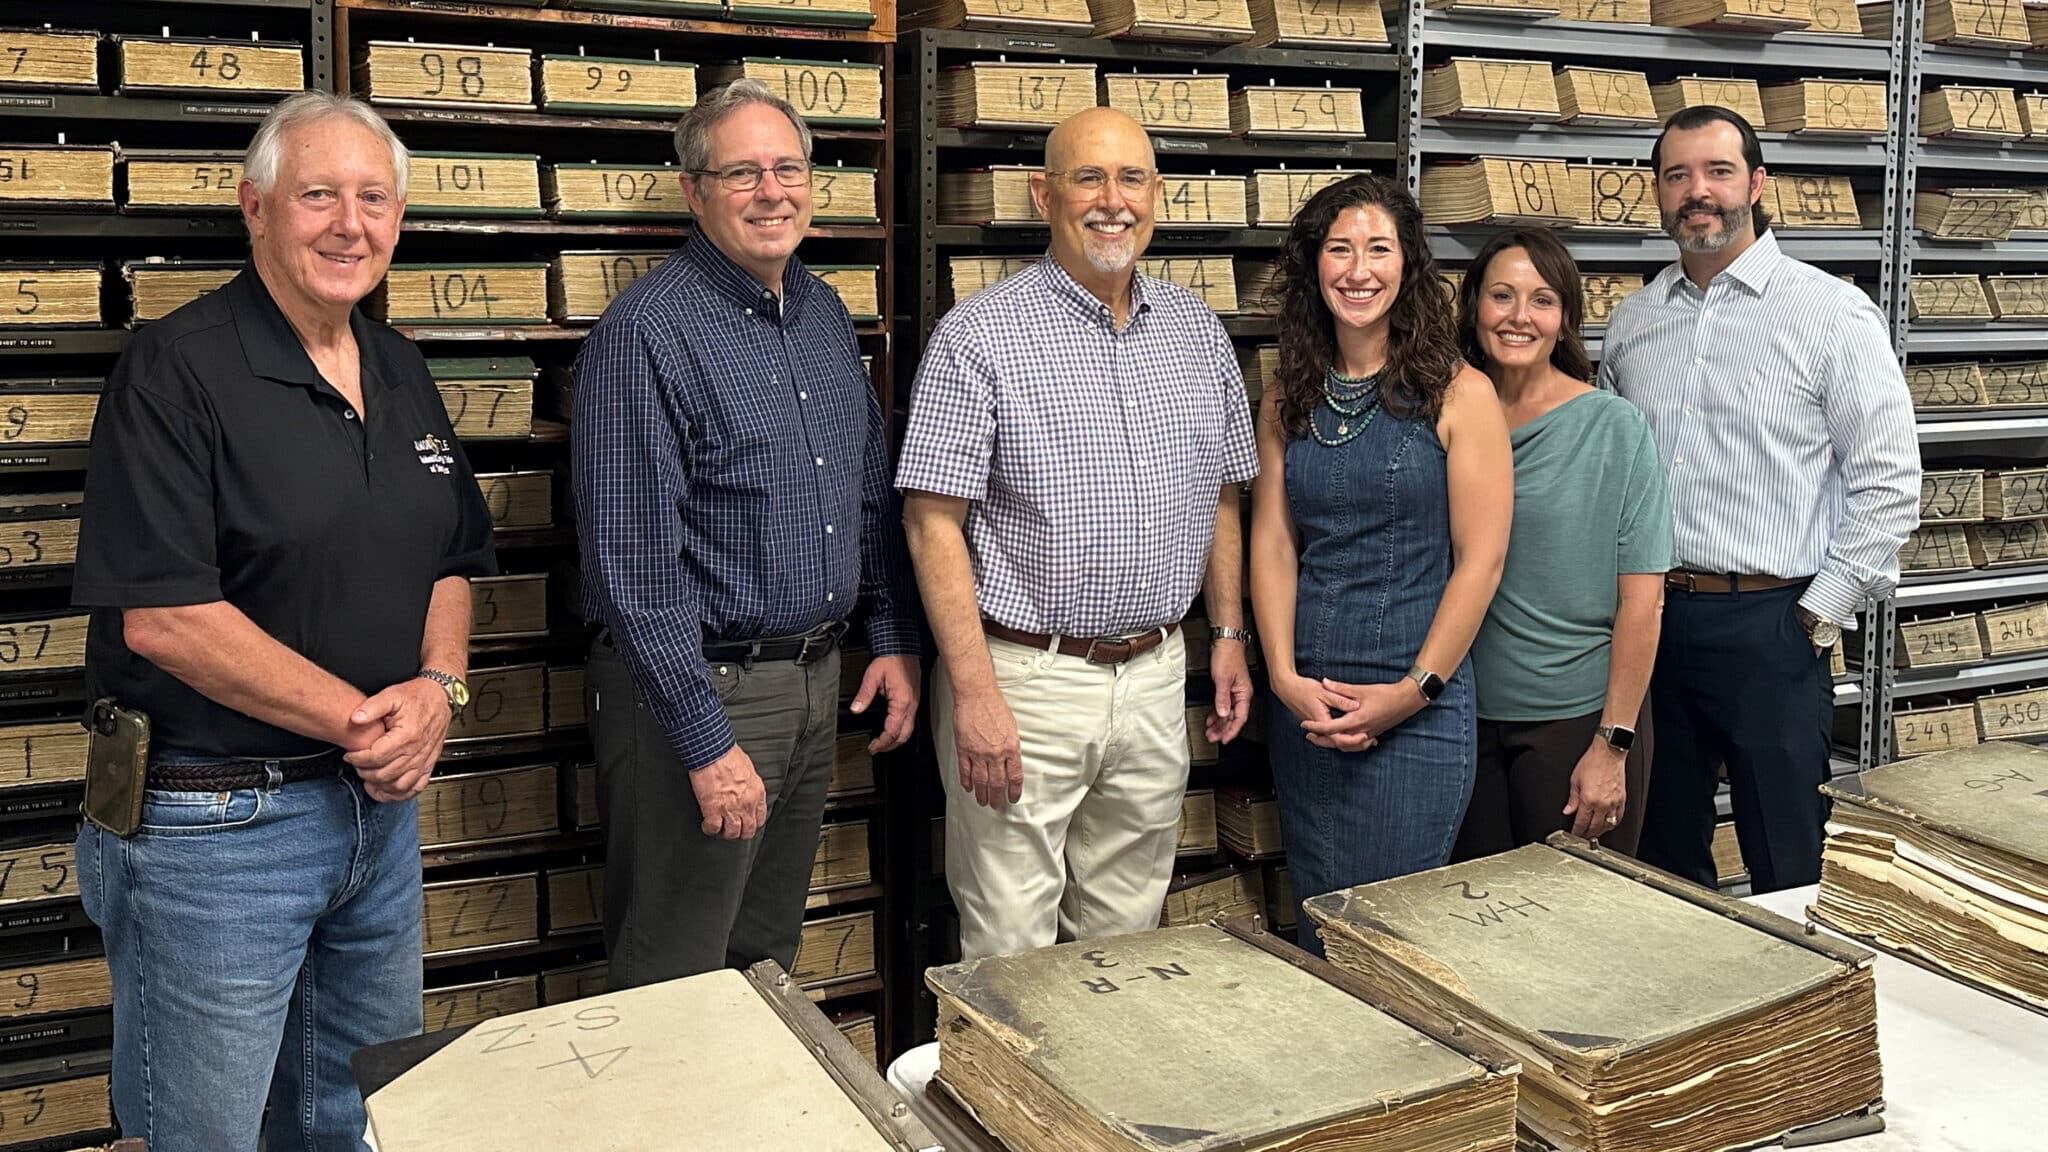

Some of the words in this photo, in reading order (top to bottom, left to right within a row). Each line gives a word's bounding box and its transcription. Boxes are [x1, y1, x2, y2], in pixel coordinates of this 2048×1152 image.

[190, 47, 242, 80] 48
[420, 53, 485, 98] 98
[586, 67, 633, 92] 99
[784, 69, 848, 114] 100
[1016, 76, 1067, 113] 137
[1134, 80, 1194, 123] 138
[1588, 72, 1637, 115] 178
[1823, 84, 1869, 129] 180
[1960, 90, 2007, 131] 221
[1272, 92, 1340, 132] 139
[191, 167, 237, 191] 52
[435, 164, 486, 192] 101
[601, 173, 663, 203] 102
[1286, 173, 1344, 217] 14
[1507, 160, 1559, 216] 181
[1591, 170, 1648, 224] 182
[1162, 181, 1212, 222] 141
[1948, 200, 2021, 237] 225
[15, 279, 40, 315] 5
[429, 274, 500, 319] 104
[600, 256, 668, 299] 10
[1913, 368, 1979, 405] 233
[1988, 364, 2048, 403] 234
[1921, 475, 1979, 518] 237
[2010, 474, 2048, 517] 23
[1909, 526, 1957, 569] 241
[1918, 633, 1959, 656] 245
[2000, 619, 2035, 641] 246
[1905, 721, 1951, 745] 249
[1999, 701, 2041, 727] 250
[1440, 880, 1490, 900] 2
[1080, 950, 1120, 968] 3
[1080, 962, 1192, 994] N-R
